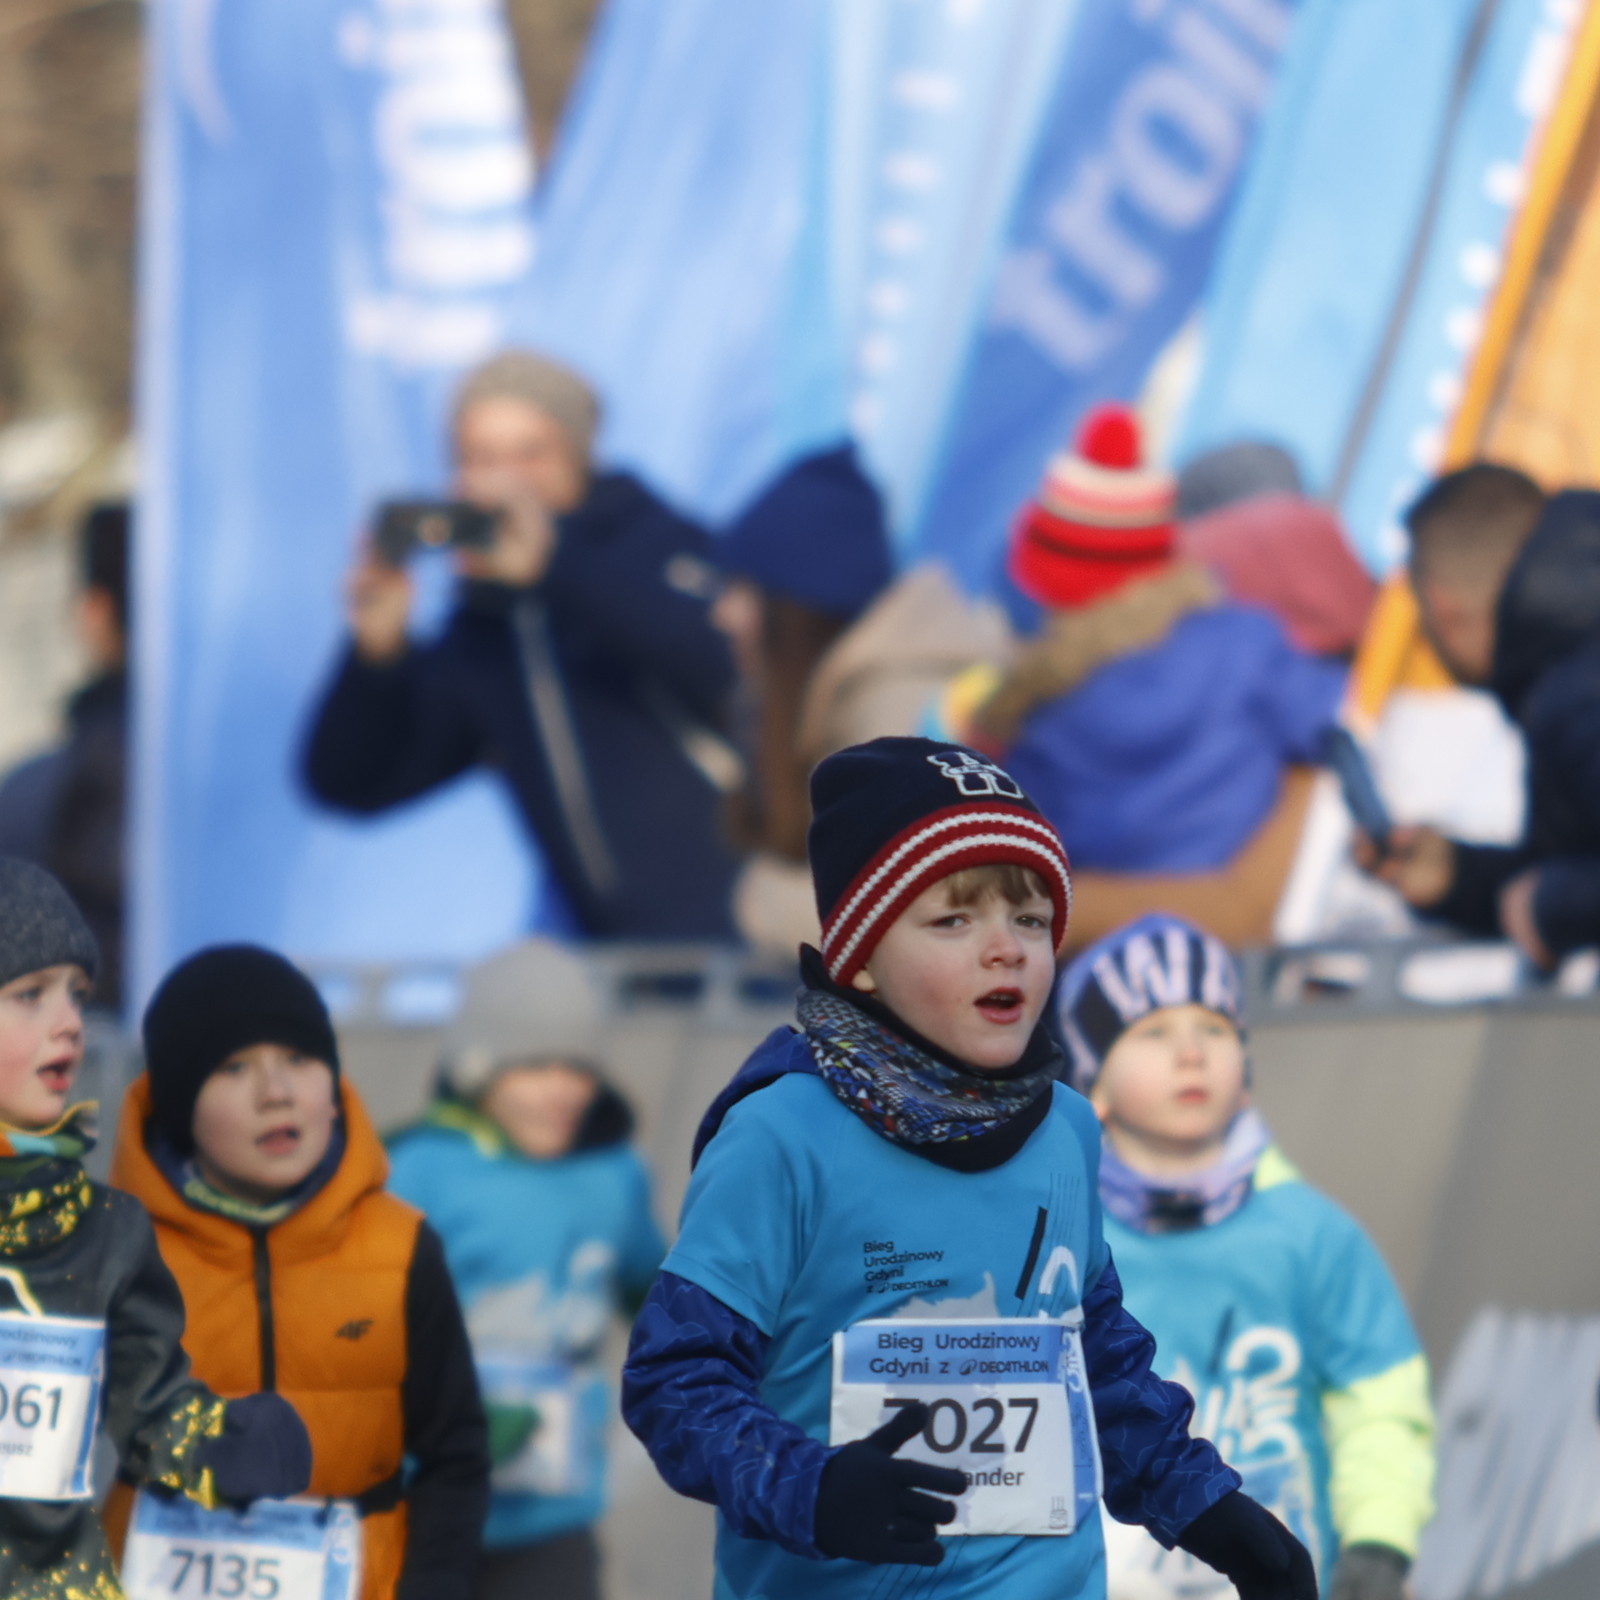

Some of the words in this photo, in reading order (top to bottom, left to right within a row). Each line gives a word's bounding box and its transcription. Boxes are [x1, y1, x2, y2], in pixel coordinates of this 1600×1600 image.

[863, 1241, 895, 1253] Bieg
[864, 1251, 945, 1267] Urodzinowy
[864, 1265, 905, 1282] Gdyni
[892, 1279, 949, 1291] DECATHLON
[877, 1333, 923, 1353] Bieg
[935, 1333, 1040, 1352] Urodzinowy
[869, 1357, 929, 1378] Gdyni
[940, 1361, 949, 1374] z
[979, 1360, 1049, 1373] DECATHLON
